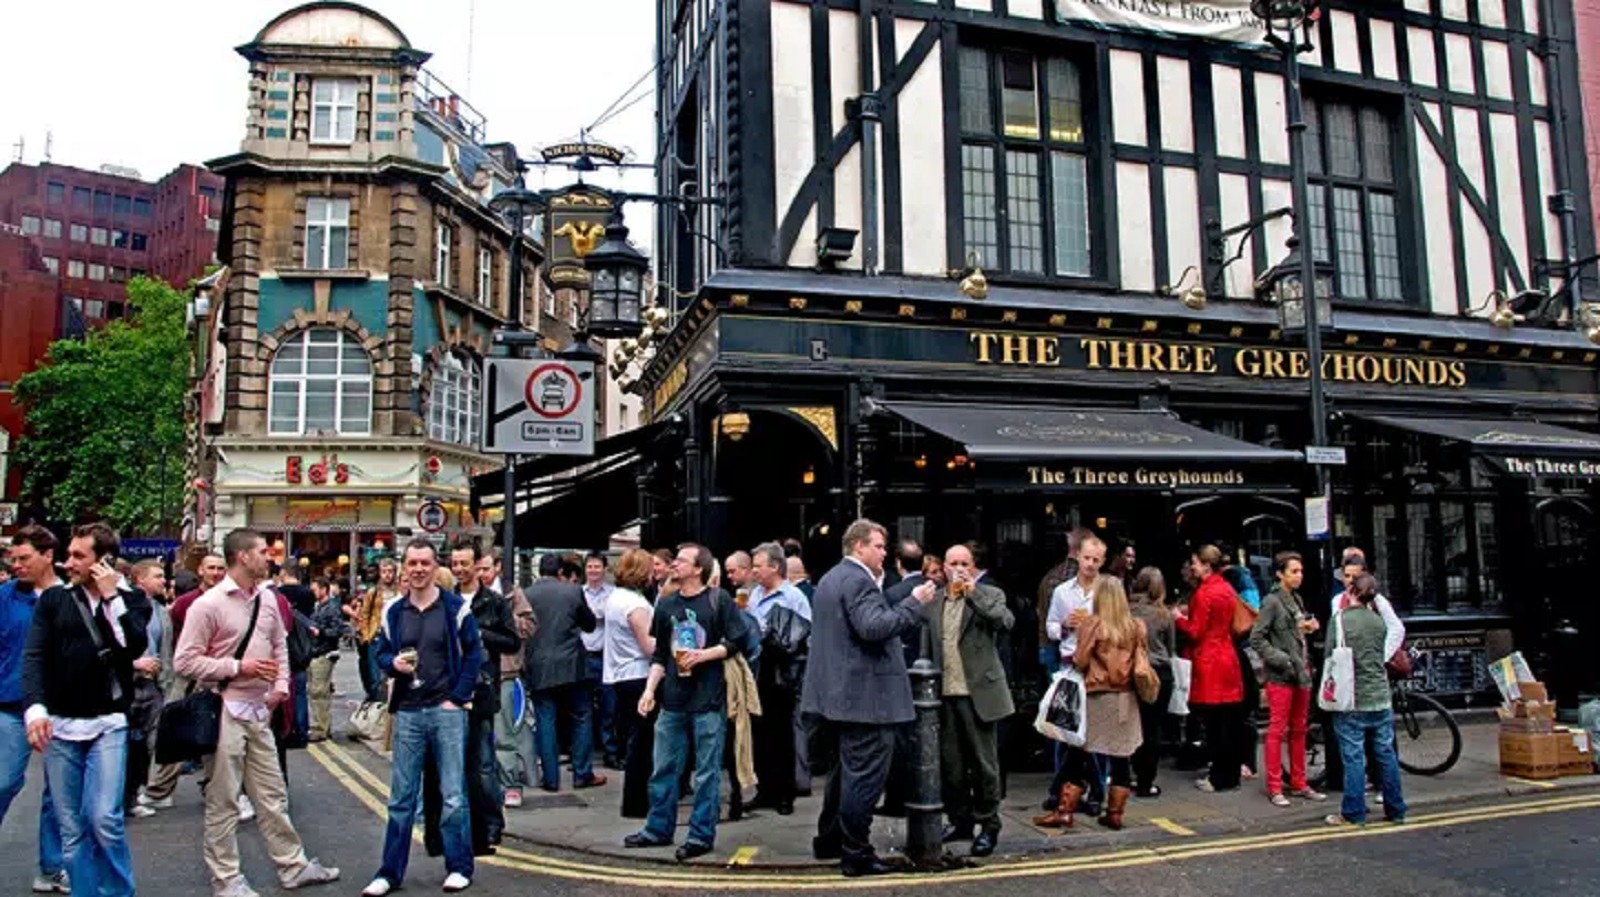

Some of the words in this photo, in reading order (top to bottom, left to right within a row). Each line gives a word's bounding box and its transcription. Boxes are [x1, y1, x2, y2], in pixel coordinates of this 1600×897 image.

[1180, 5, 1231, 23] FROM
[970, 332, 1061, 366] THE
[1081, 338, 1218, 374] THREE
[1235, 348, 1466, 387] GREYHOUNDS
[286, 453, 349, 485] Ed's
[1505, 457, 1534, 473] The
[1535, 458, 1577, 474] Three
[1027, 466, 1065, 484] The
[1071, 466, 1129, 484] Three
[1135, 467, 1244, 488] Greyhounds
